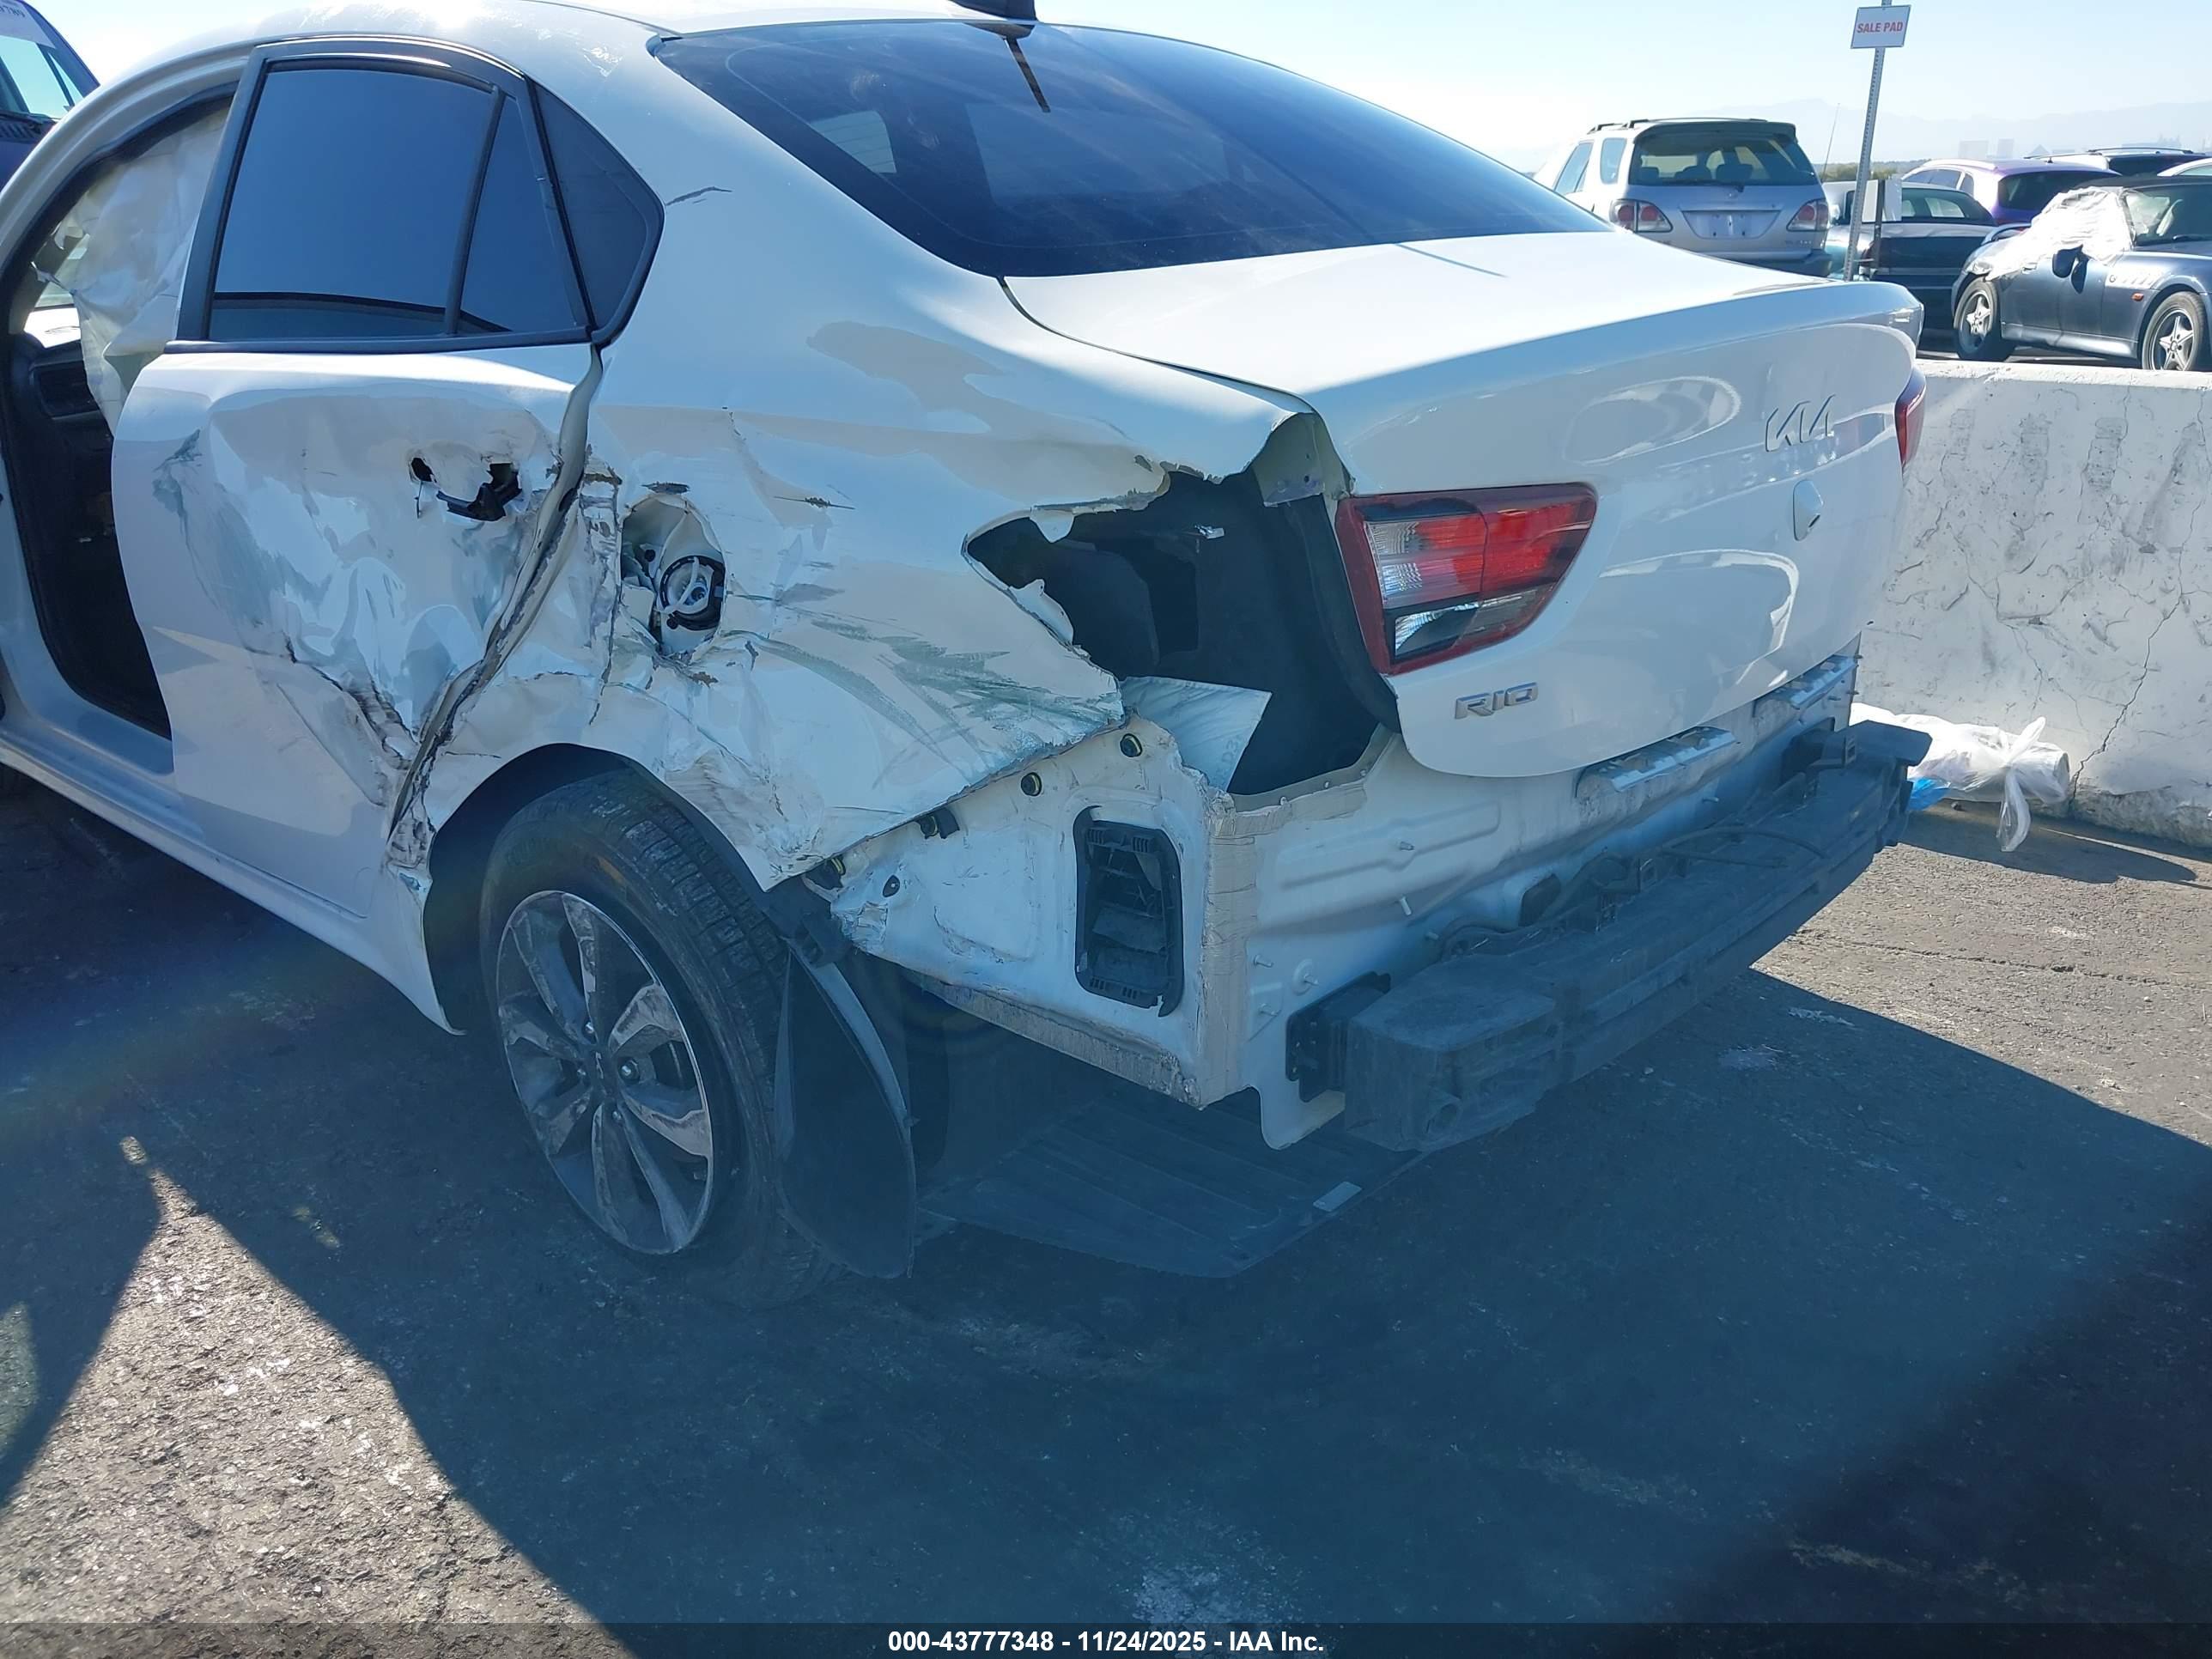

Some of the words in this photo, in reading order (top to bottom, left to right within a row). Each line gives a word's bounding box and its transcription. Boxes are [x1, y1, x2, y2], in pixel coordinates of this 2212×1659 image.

[1856, 22, 1881, 33] SALE
[1883, 21, 1904, 33] PAD
[1765, 394, 1836, 453] KIA
[1454, 682, 1539, 720] RIO
